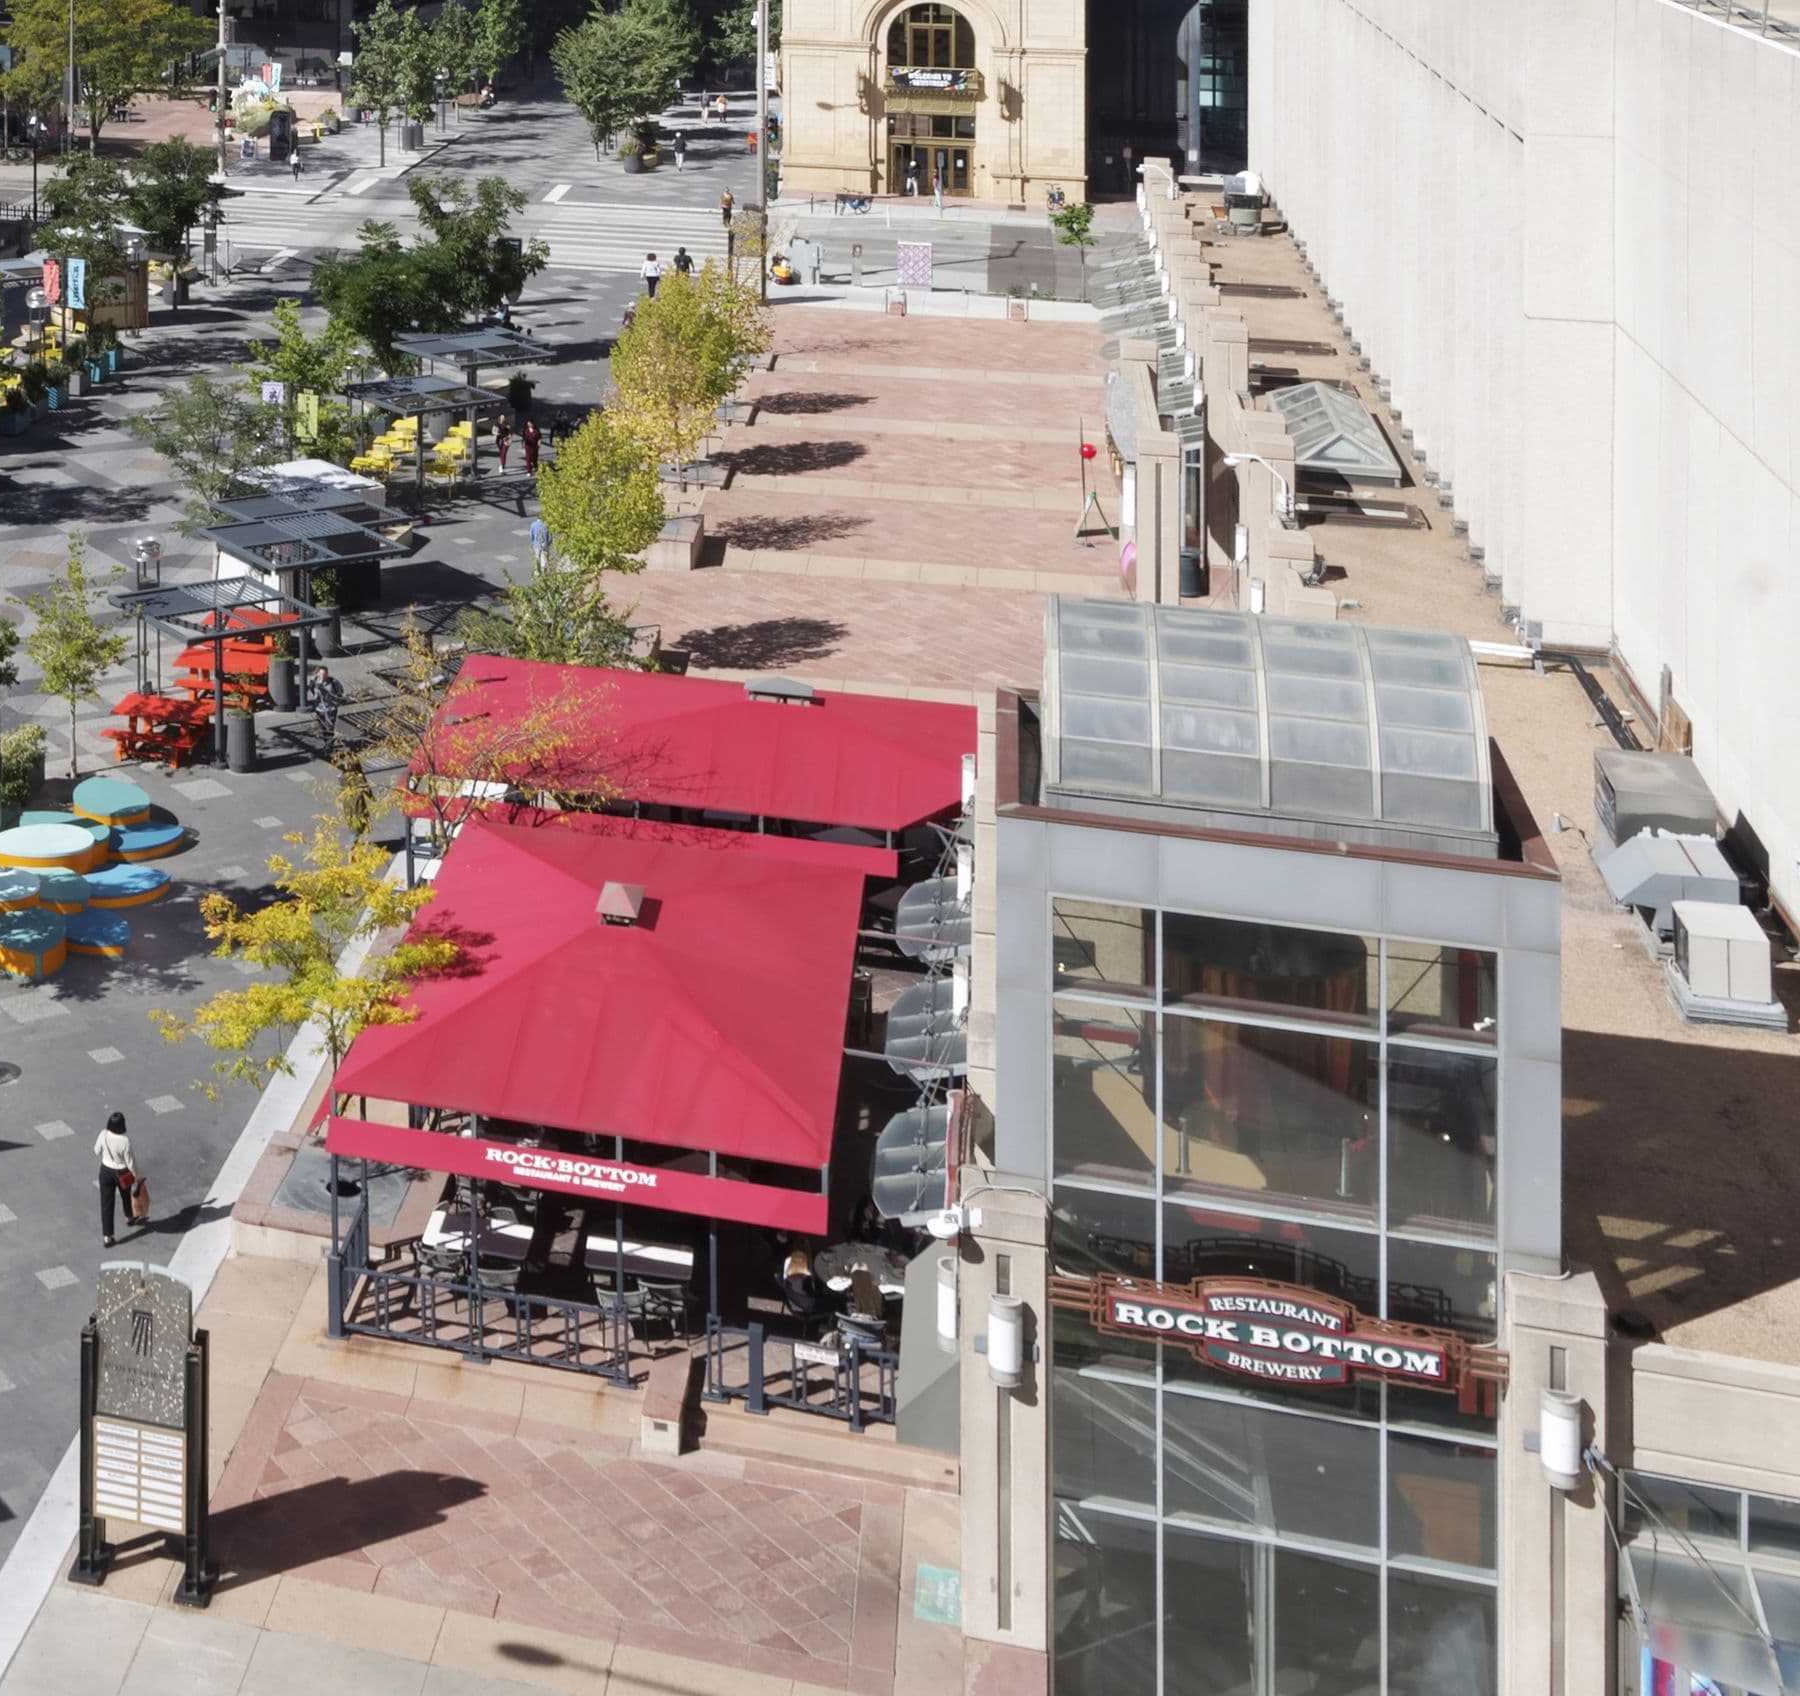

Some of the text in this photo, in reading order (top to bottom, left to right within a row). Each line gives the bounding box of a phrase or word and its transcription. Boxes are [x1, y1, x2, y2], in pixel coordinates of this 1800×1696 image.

[513, 1166, 572, 1184] RESTAURANT
[1209, 1297, 1340, 1330] RESTAURANT
[1115, 1302, 1440, 1376] ROCK BOTTOM
[1228, 1352, 1322, 1380] BREWERY
